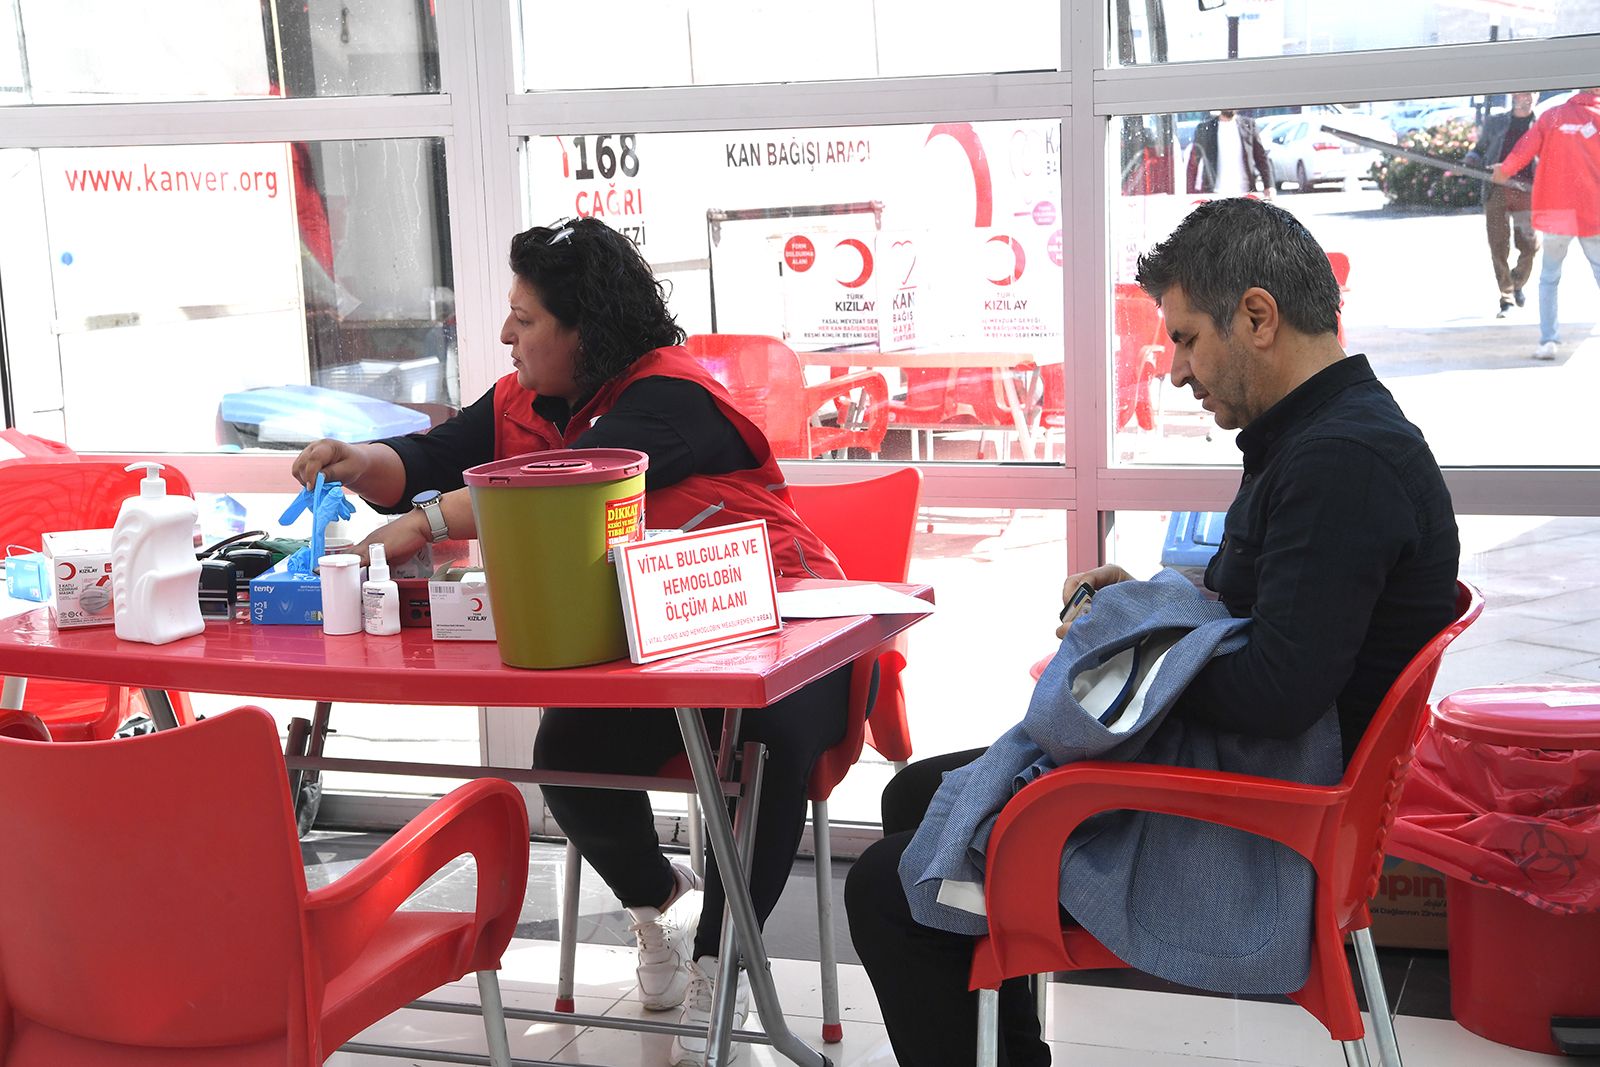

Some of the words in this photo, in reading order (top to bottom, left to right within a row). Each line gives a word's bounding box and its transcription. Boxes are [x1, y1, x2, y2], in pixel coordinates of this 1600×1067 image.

[573, 134, 640, 180] 168
[726, 142, 761, 168] KAN
[767, 136, 821, 172] BAĞIŞI
[65, 163, 278, 199] www.kanver.org
[835, 301, 876, 312] KIZILAY
[892, 291, 915, 310] KAN
[984, 300, 1028, 311] KIZILAY
[607, 503, 639, 522] DİKKAT
[638, 554, 674, 575] VİTAL
[676, 542, 740, 568] BULGULAR
[742, 538, 758, 555] VE
[254, 585, 275, 594] tenty
[663, 564, 742, 596] HEMOGLOBİN
[254, 601, 264, 621] 403
[665, 597, 708, 622] ÖLÇÜM
[712, 590, 748, 612] ALANI
